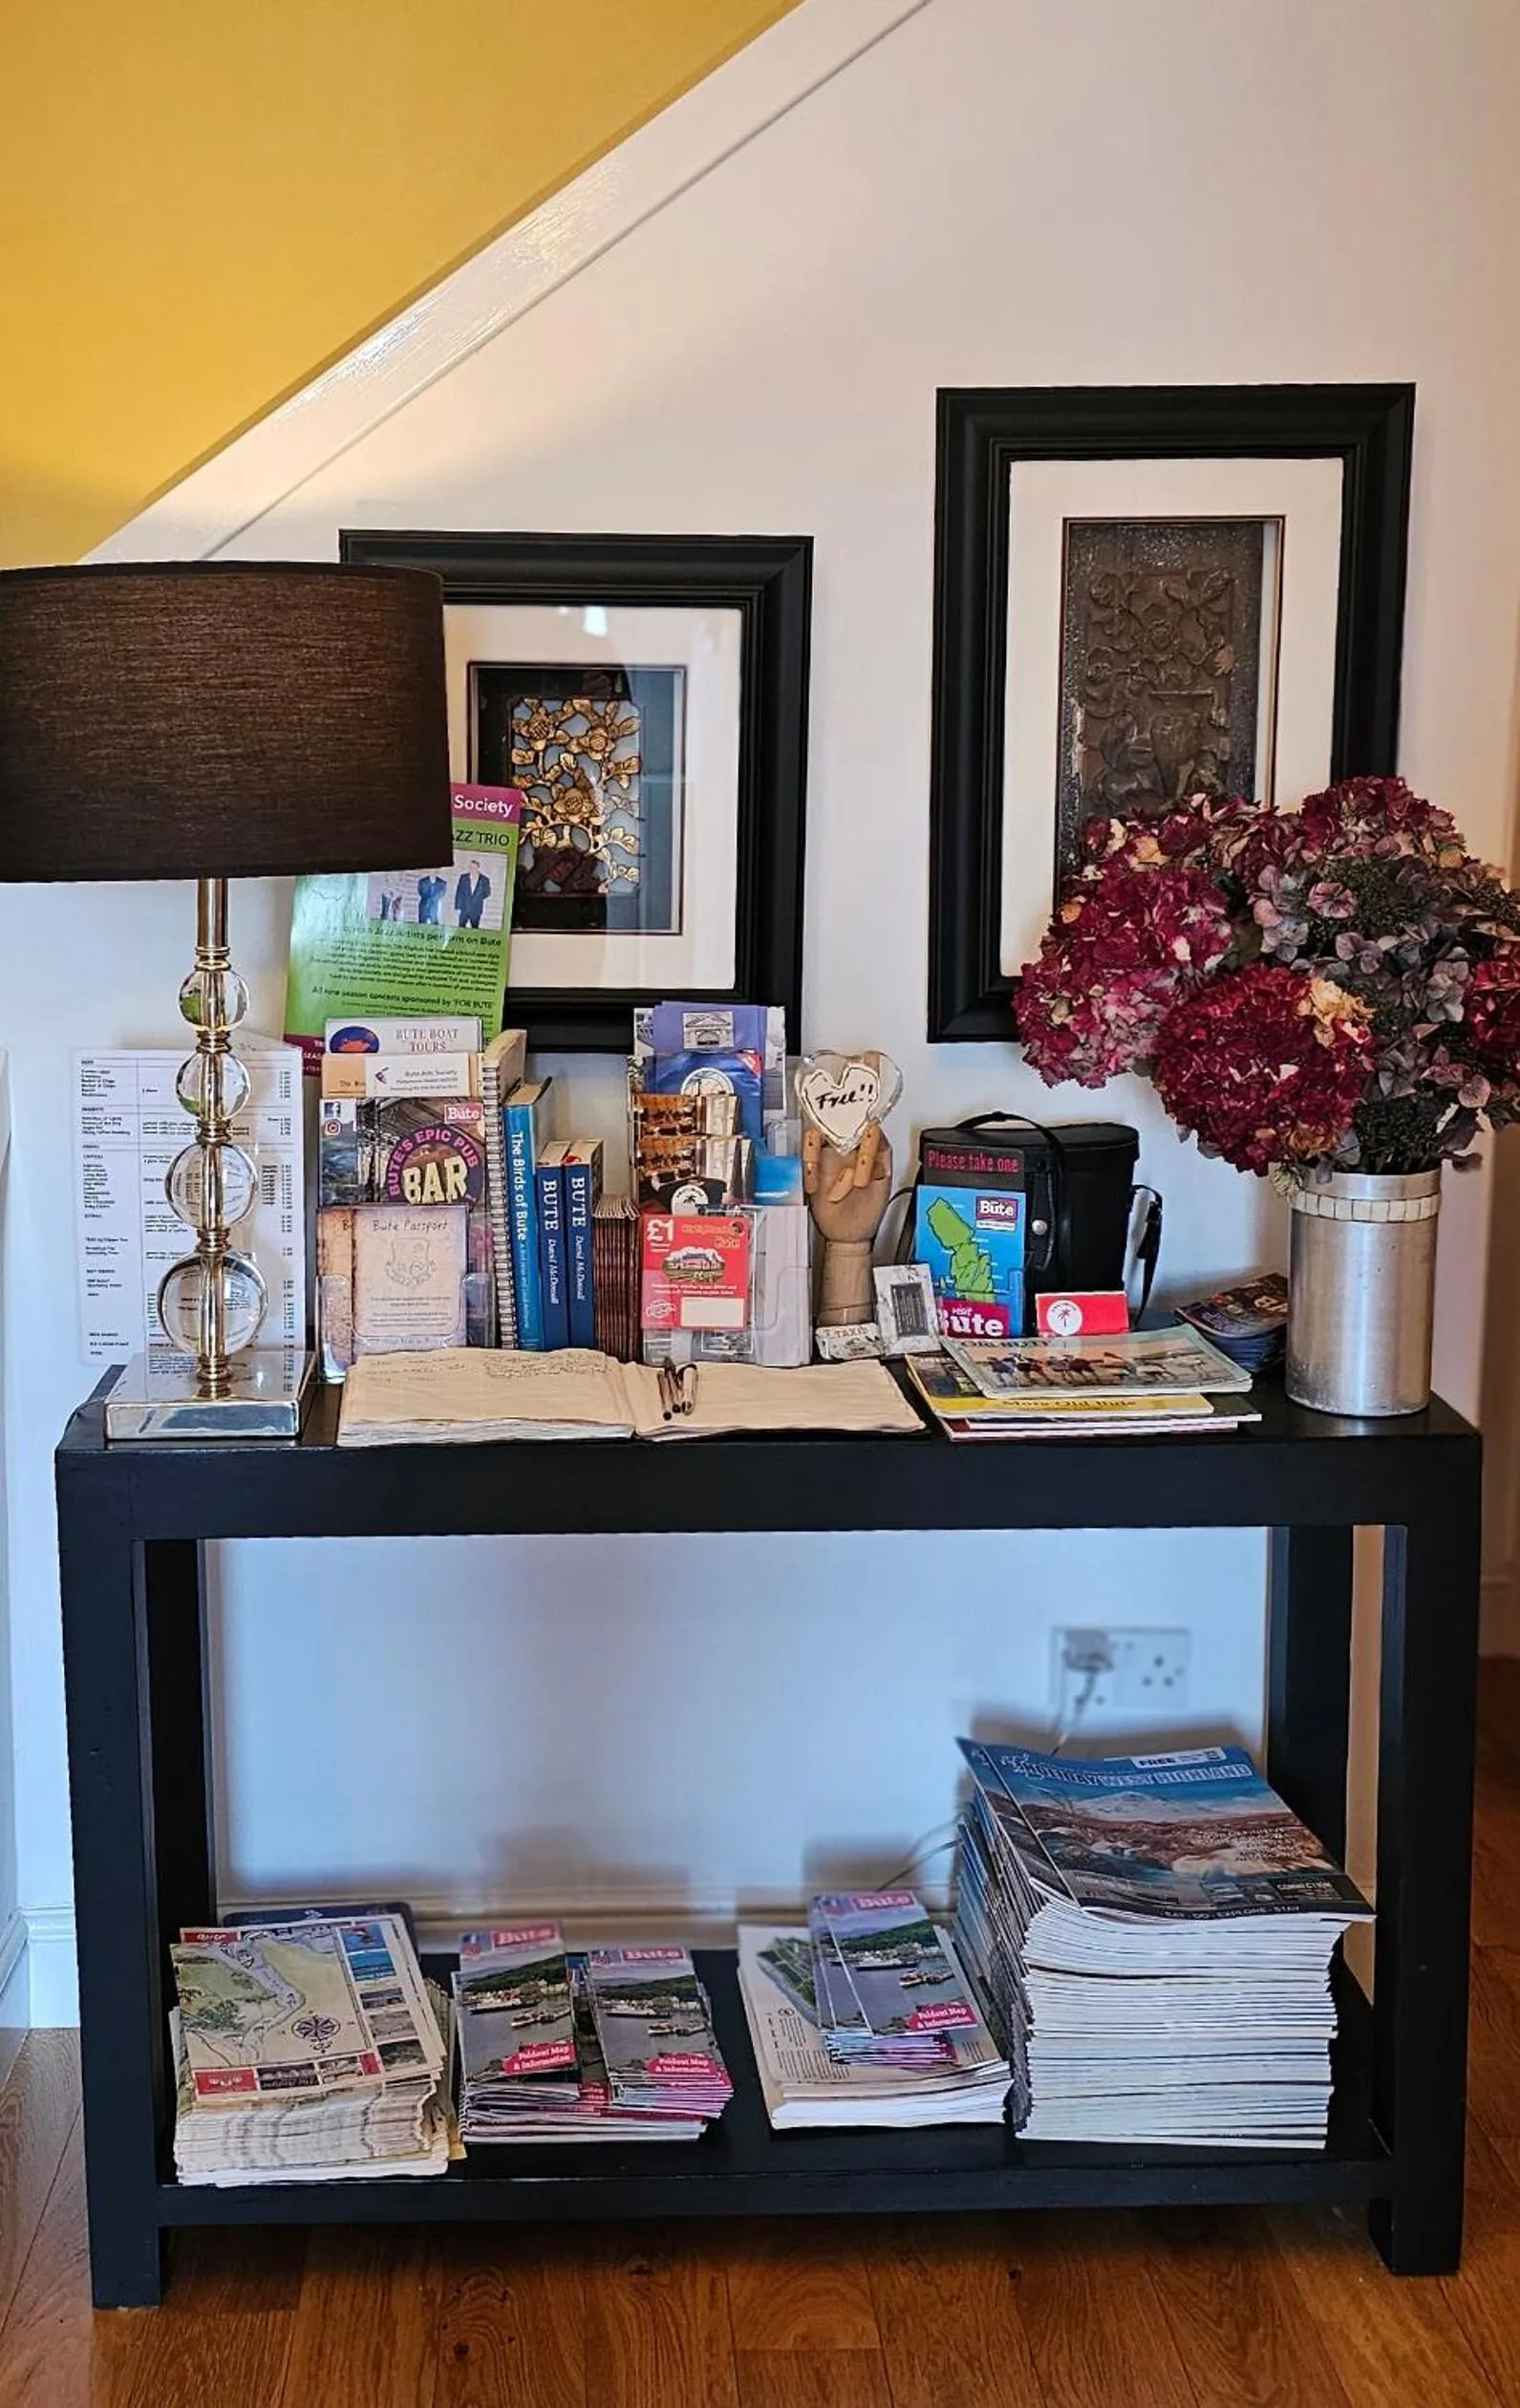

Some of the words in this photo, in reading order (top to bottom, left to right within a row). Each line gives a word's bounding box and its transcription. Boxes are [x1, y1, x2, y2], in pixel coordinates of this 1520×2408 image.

[454, 794, 513, 818] Society
[476, 831, 510, 847] TRIO
[396, 1029, 430, 1040] BUTE
[432, 1029, 460, 1040] BOAT
[409, 1041, 447, 1052] TOURS
[447, 1107, 480, 1120] Bute
[415, 1129, 452, 1144] EPIC
[453, 1136, 480, 1168] PUB
[511, 1131, 524, 1155] The
[928, 1150, 965, 1170] Please
[969, 1151, 994, 1172] take
[997, 1157, 1018, 1172] one
[402, 1155, 467, 1205] BAR
[513, 1158, 525, 1192] Birds
[516, 1193, 527, 1208] of
[543, 1179, 559, 1231] BUTE
[571, 1177, 587, 1228] BUTE
[980, 1200, 1014, 1215] Bute
[372, 1219, 398, 1232] Bute
[403, 1218, 450, 1232] Passport
[517, 1211, 528, 1241] Bute
[647, 1218, 674, 1242] £1
[1139, 1757, 1175, 1766] FREE
[500, 1928, 552, 1945] Bute
[550, 2045, 570, 2057] Map
